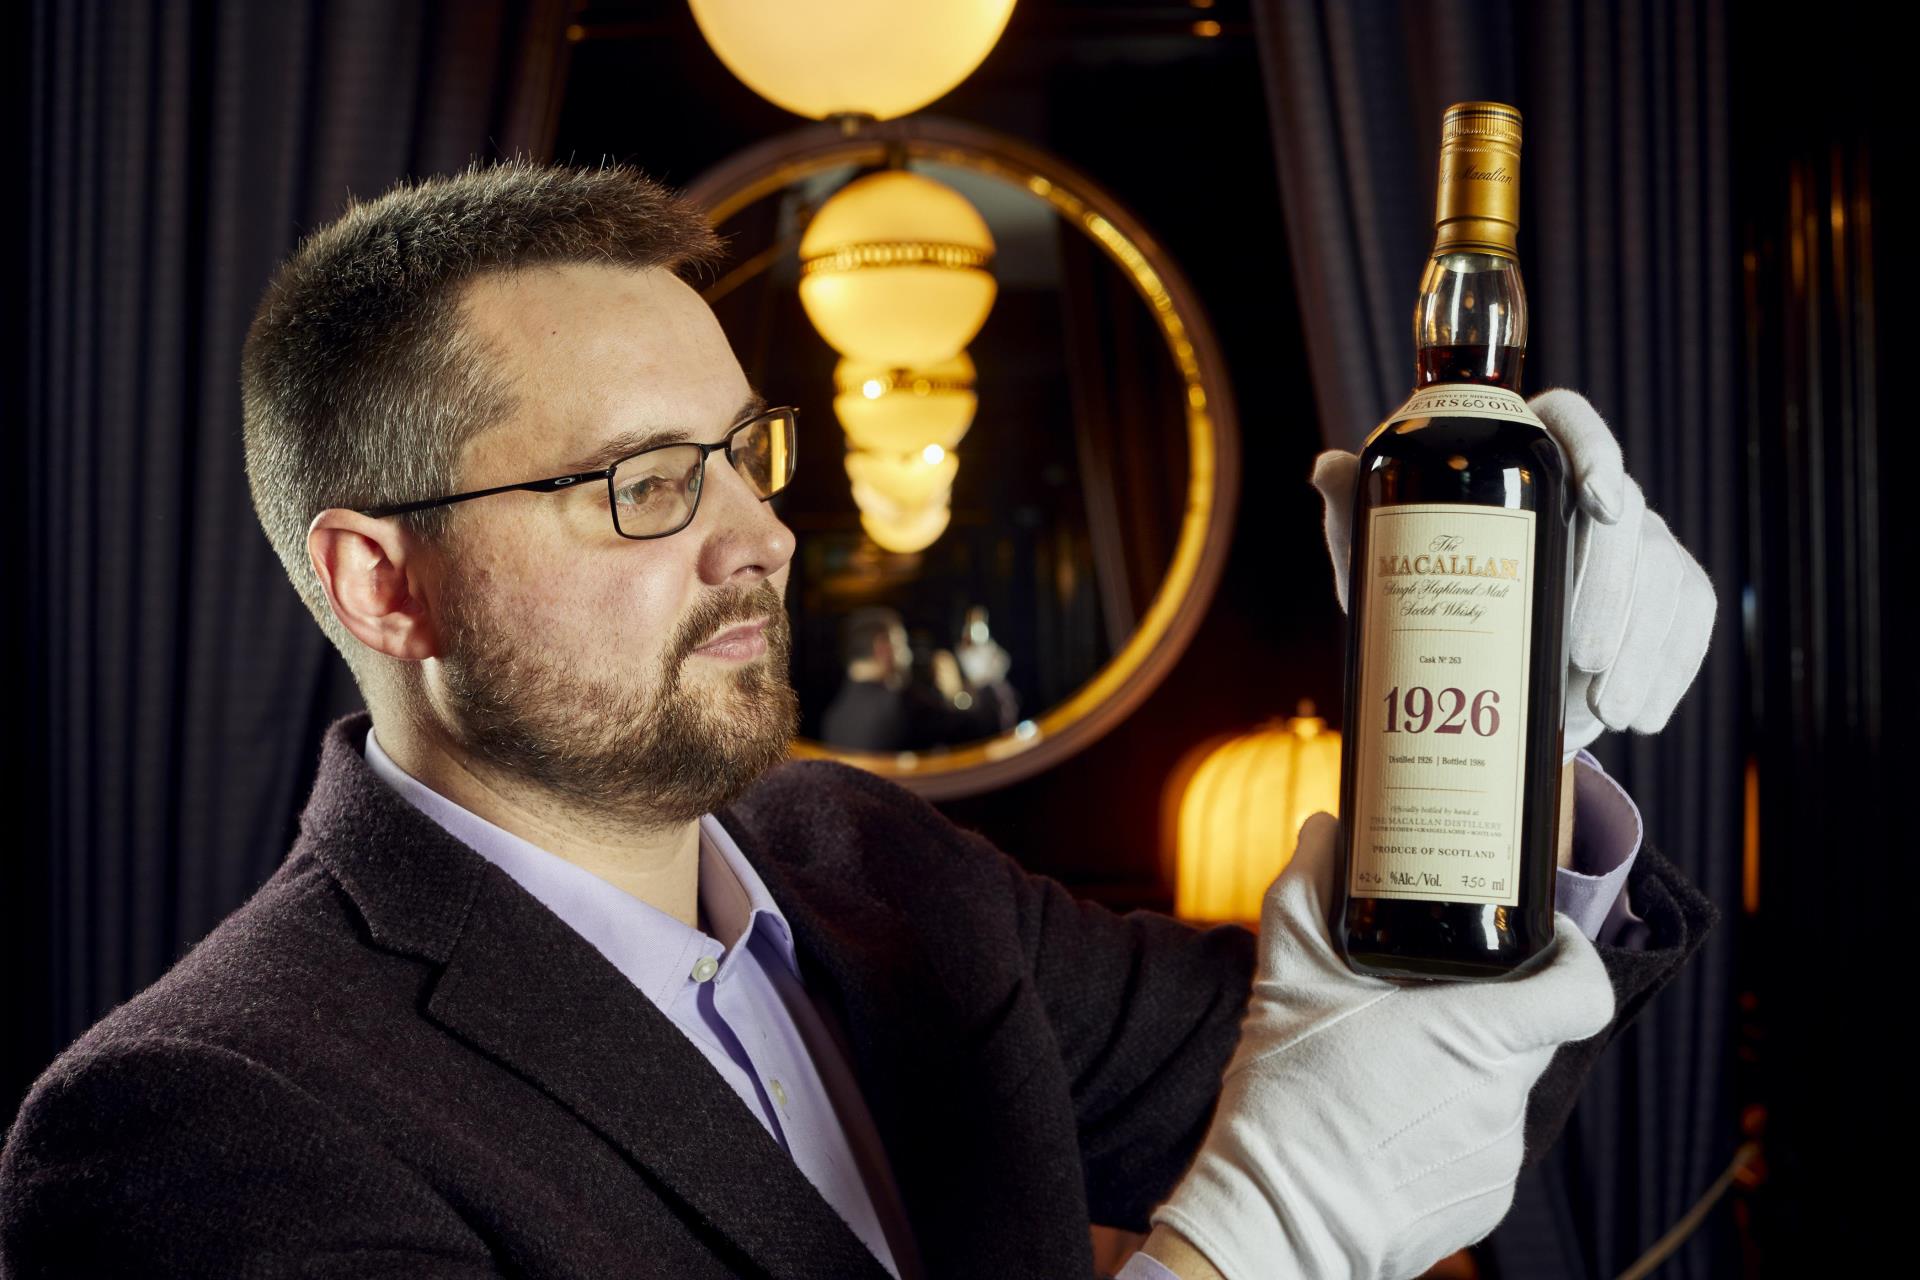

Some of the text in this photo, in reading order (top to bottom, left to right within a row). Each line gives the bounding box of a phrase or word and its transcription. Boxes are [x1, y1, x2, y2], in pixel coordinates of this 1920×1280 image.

[1462, 399, 1484, 409] 60
[1488, 401, 1523, 413] OLD
[1429, 534, 1464, 552] The
[1378, 555, 1520, 580] MACALLAN
[1383, 579, 1509, 602] Single Highland Malt
[1400, 600, 1487, 624] Scotch Whisky
[1419, 655, 1436, 664] Cask
[1449, 656, 1462, 665] 263
[1382, 686, 1500, 737] 1926
[1388, 755, 1416, 764] Distilled
[1418, 755, 1433, 764] 1926
[1442, 756, 1467, 766] Bottled
[1388, 817, 1441, 826] MACALLAN
[1444, 819, 1502, 831] DISTILLERY
[1372, 845, 1418, 855] PRODUCE
[1421, 847, 1435, 856] OF
[1437, 848, 1496, 859] SCOTLAND
[1461, 875, 1486, 889] 750
[1491, 878, 1505, 891] ml
